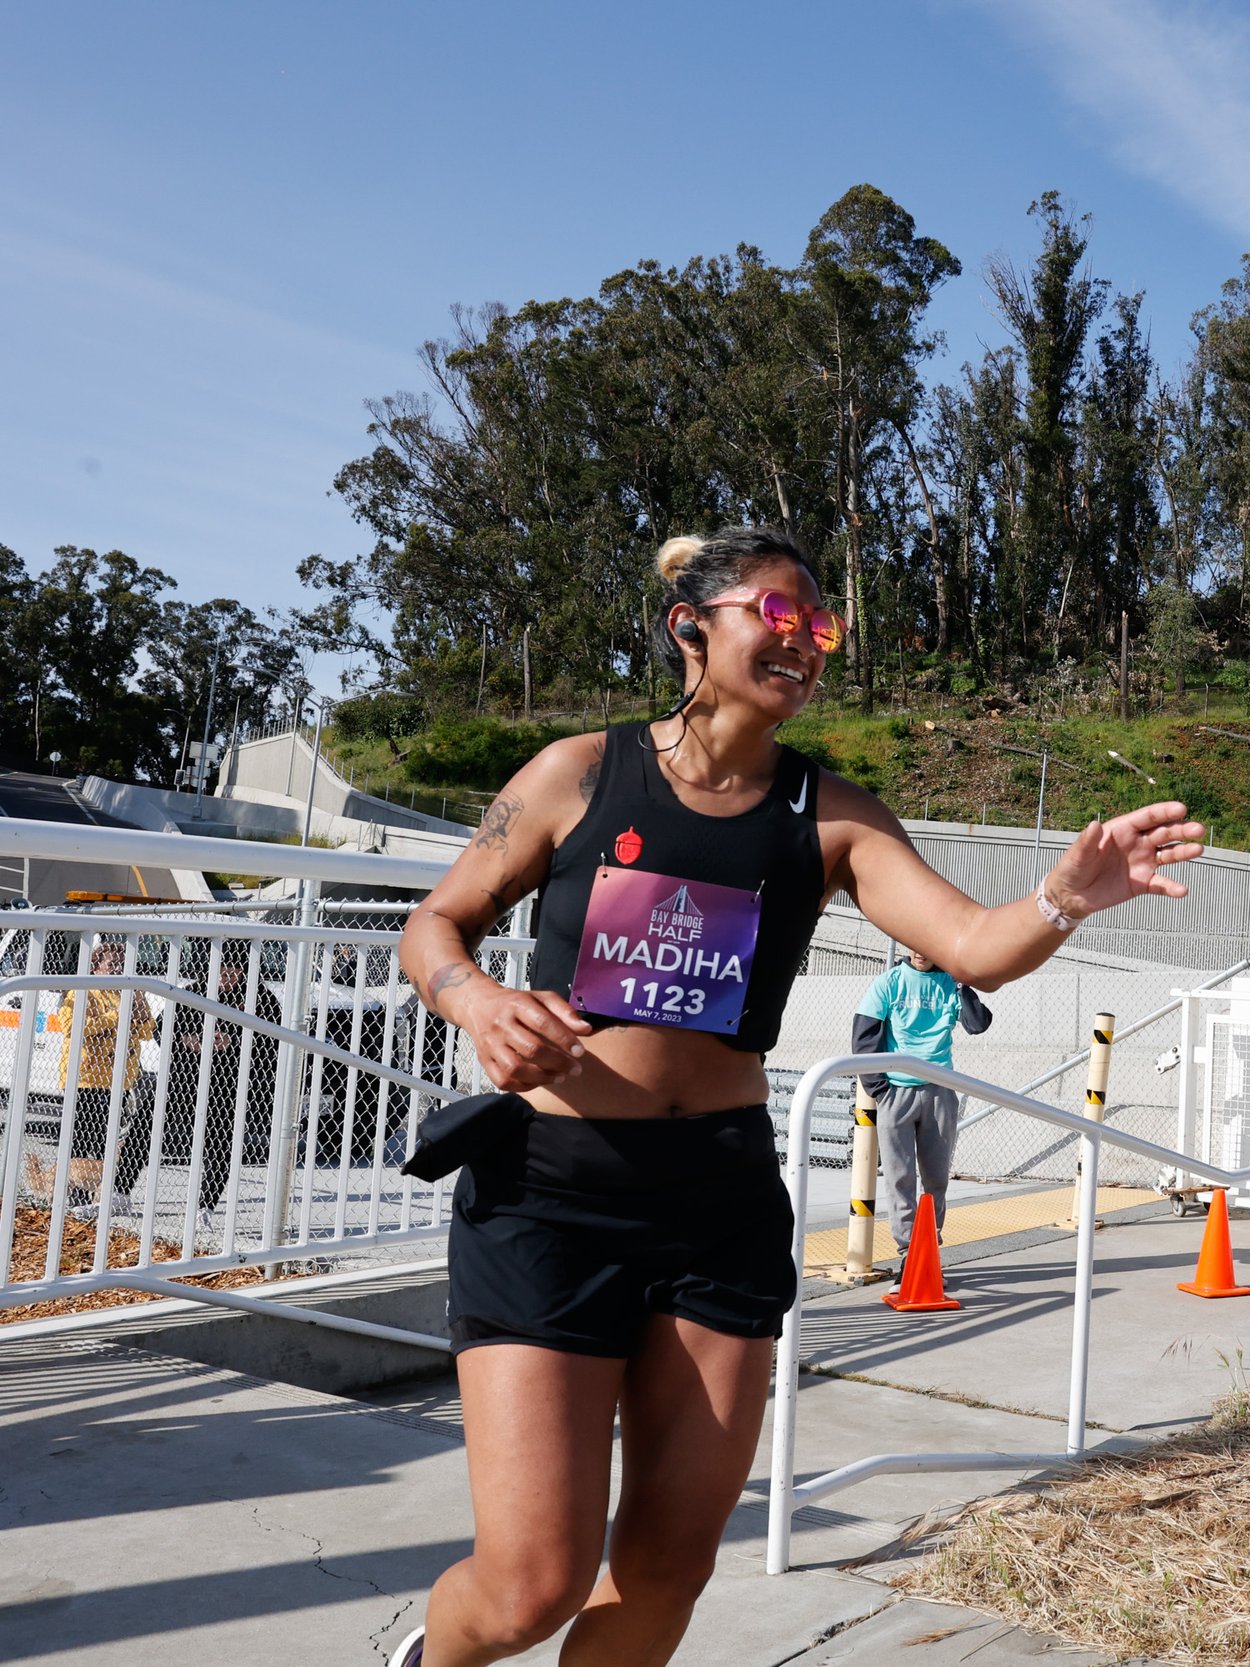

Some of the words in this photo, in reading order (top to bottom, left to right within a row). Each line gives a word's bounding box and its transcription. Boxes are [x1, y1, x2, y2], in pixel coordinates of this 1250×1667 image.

[650, 909, 669, 924] BAY
[671, 912, 704, 930] BRIDGE
[647, 922, 703, 943] HALF
[592, 932, 744, 983] MADIHA
[620, 977, 706, 1015] 1123
[633, 1008, 653, 1018] MAY
[653, 1012, 661, 1021] 7,
[661, 1013, 682, 1023] 2023
